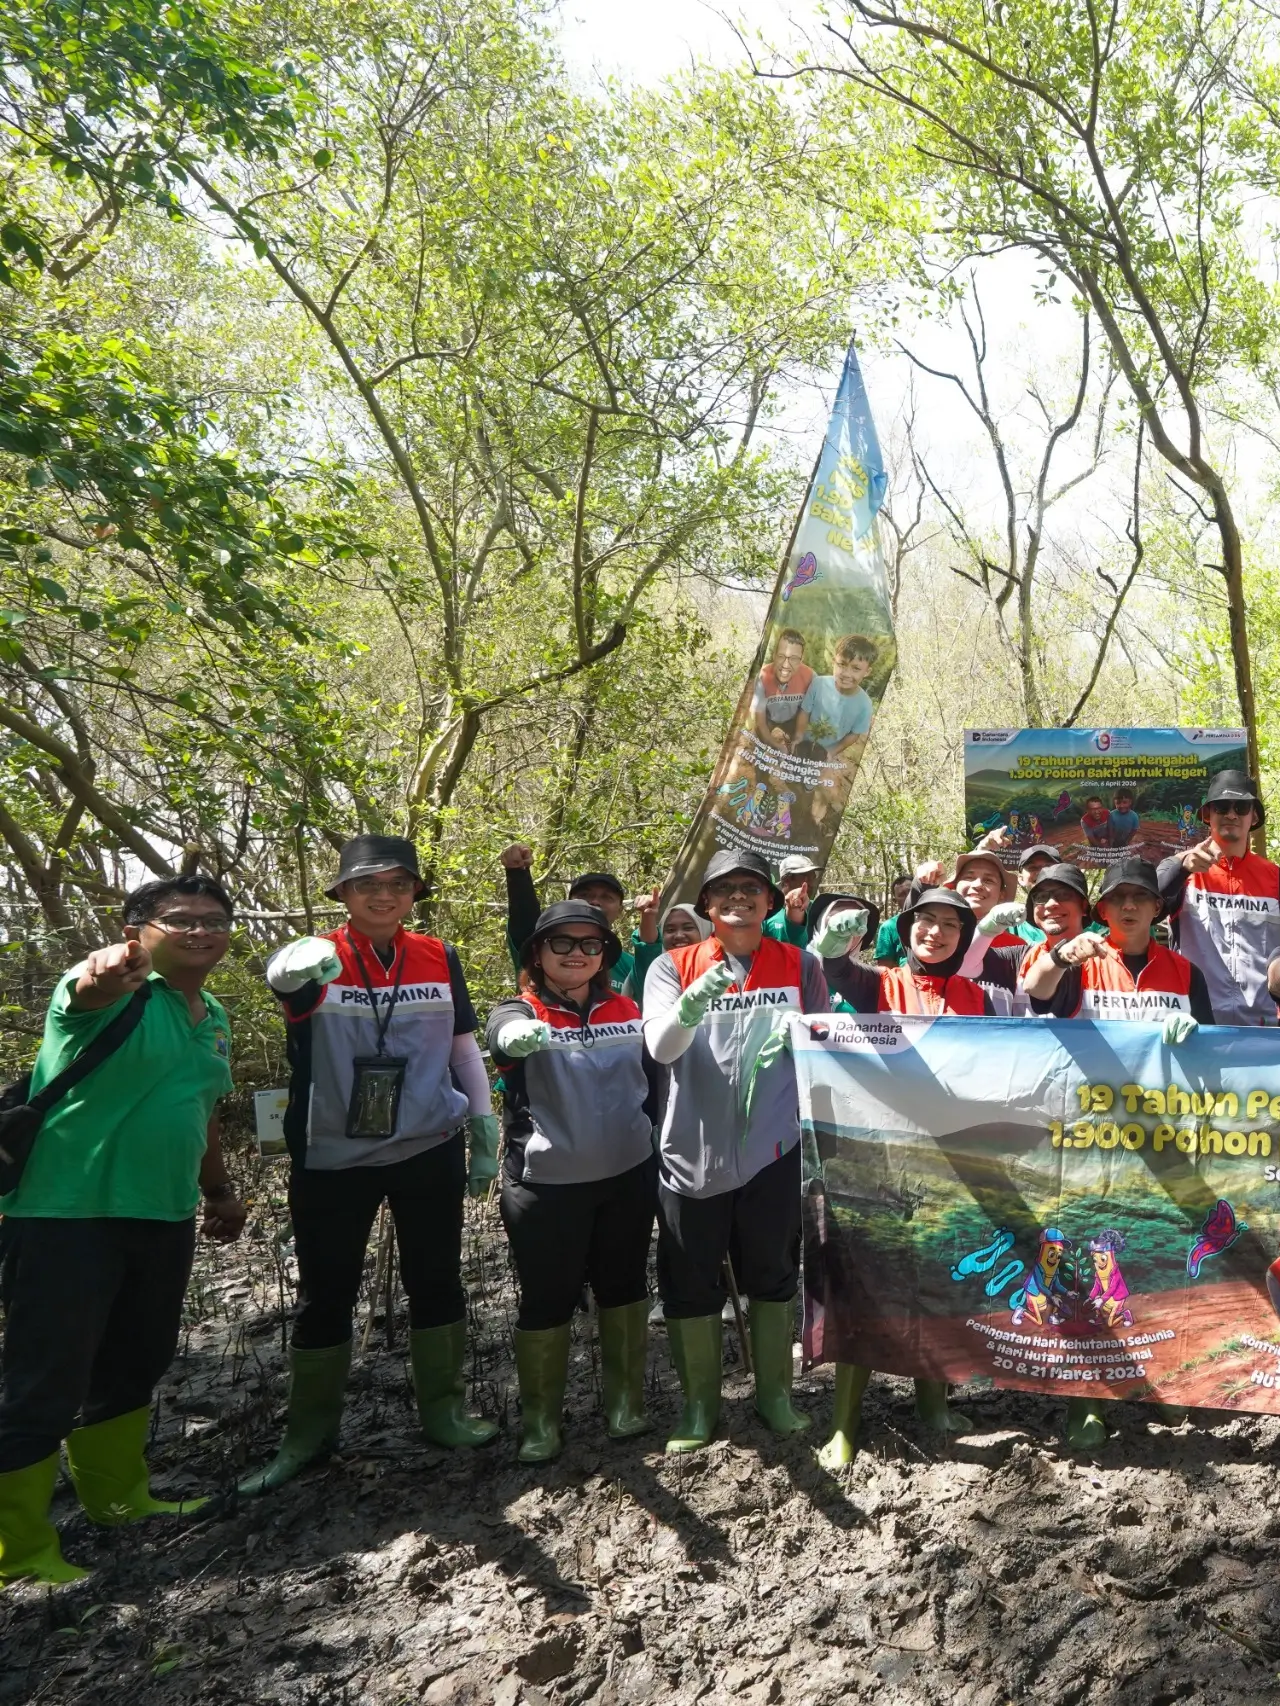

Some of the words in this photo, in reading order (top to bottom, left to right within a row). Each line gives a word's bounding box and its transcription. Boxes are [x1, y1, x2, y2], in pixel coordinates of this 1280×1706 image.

[753, 748, 779, 766] Dalam
[780, 760, 821, 777] Rangka
[754, 759, 802, 782] Pertagas
[803, 776, 834, 787] Ke-19
[1009, 768, 1042, 779] 1.900
[1044, 768, 1085, 779] Pohon
[1087, 768, 1121, 778] Bakti
[1124, 767, 1162, 777] Untuk
[1165, 767, 1208, 780] Negeri
[1018, 756, 1031, 766] 19
[1033, 755, 1074, 766] Tahun
[1075, 755, 1135, 768] Pertagas
[1137, 754, 1198, 768] Mengabdi
[1094, 995, 1181, 1009] PERTAMINA
[833, 1032, 897, 1046] Indonesia
[836, 1021, 902, 1034] Danantara
[1077, 1084, 1114, 1113] 19
[1121, 1084, 1238, 1117] Tahun
[1049, 1121, 1145, 1151] 1.900
[1153, 1123, 1271, 1157] Pohon
[965, 1319, 1031, 1346] Peringatan
[1032, 1335, 1058, 1349] Hari
[1059, 1338, 1126, 1351] Kehutanan
[1127, 1327, 1175, 1347] Sedunia
[986, 1340, 995, 1350] &
[997, 1345, 1023, 1358] Hari
[1024, 1349, 1064, 1364] Hutan
[1065, 1347, 1153, 1365] Internasional
[992, 1356, 1014, 1370] 20
[1016, 1362, 1028, 1374] &
[1030, 1365, 1046, 1379] 21
[1050, 1366, 1101, 1382] Maret
[1105, 1363, 1146, 1380] 2026
